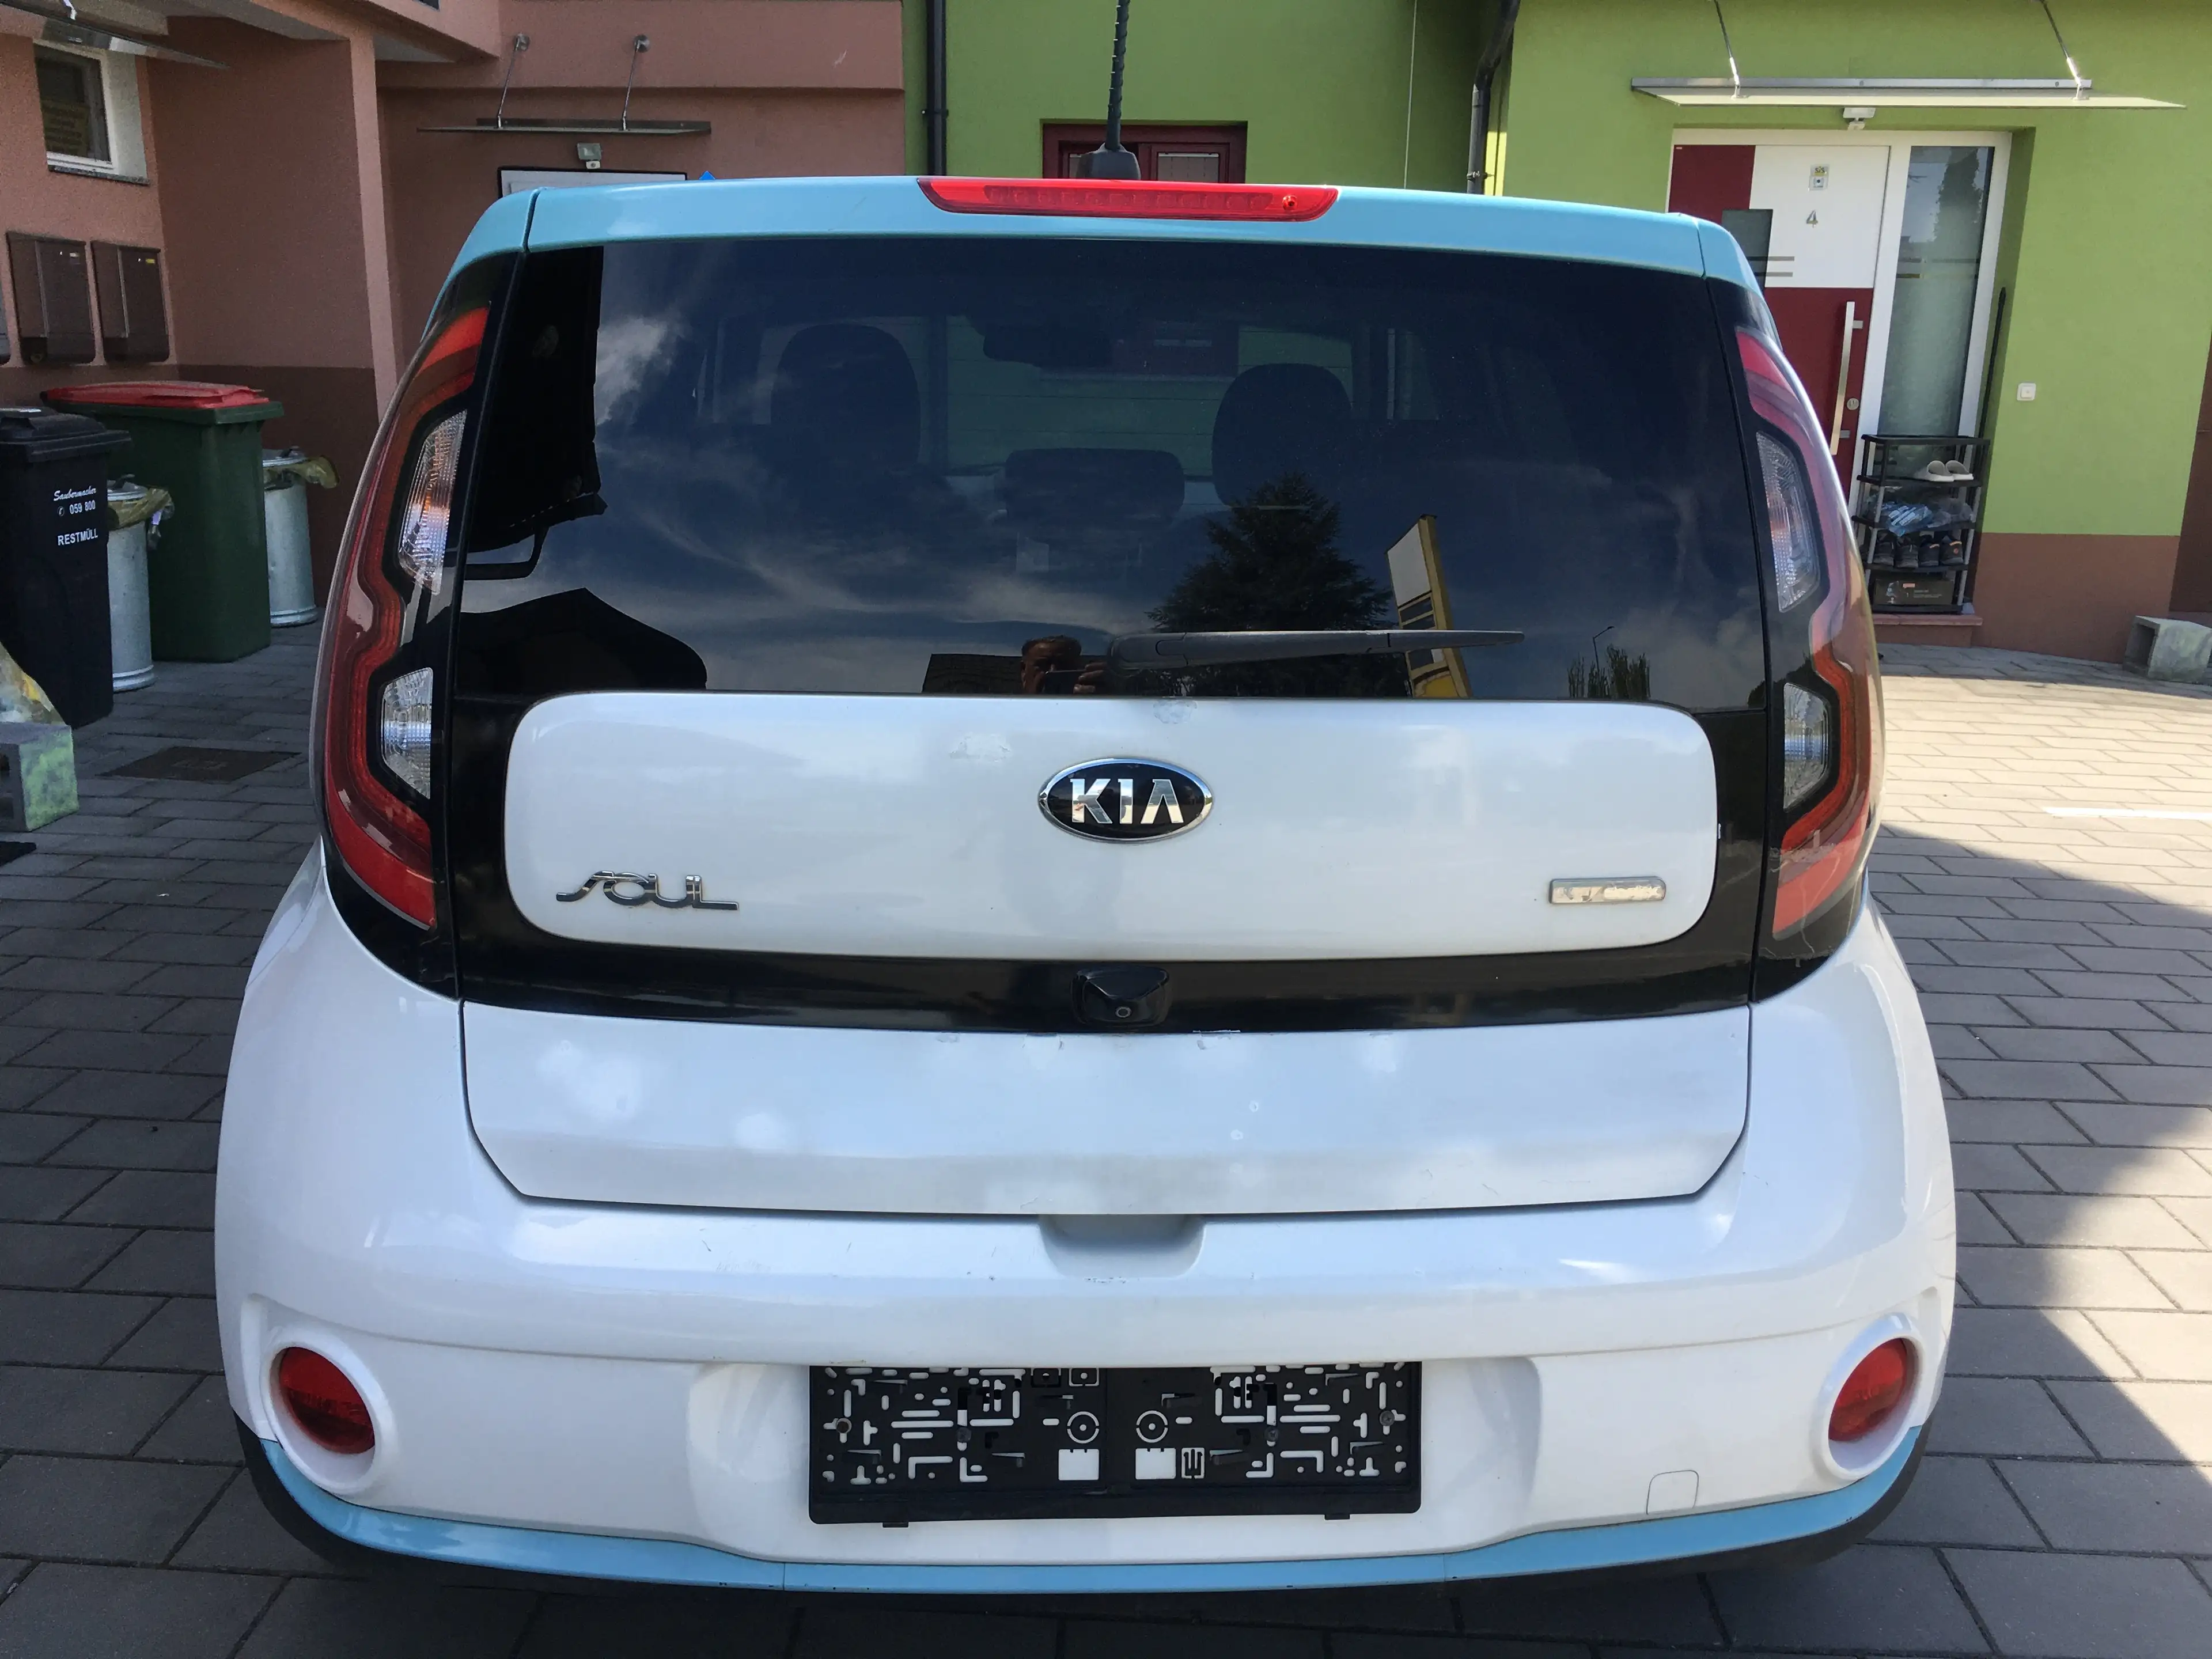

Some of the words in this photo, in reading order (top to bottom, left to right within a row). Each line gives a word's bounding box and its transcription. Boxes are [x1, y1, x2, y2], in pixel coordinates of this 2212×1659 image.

[1806, 209, 1819, 228] 4
[69, 503, 82, 514] 059
[84, 499, 96, 511] 800
[58, 528, 99, 546] RESTMÜLL
[1070, 778, 1184, 824] KIA
[556, 870, 738, 910] SOUL
